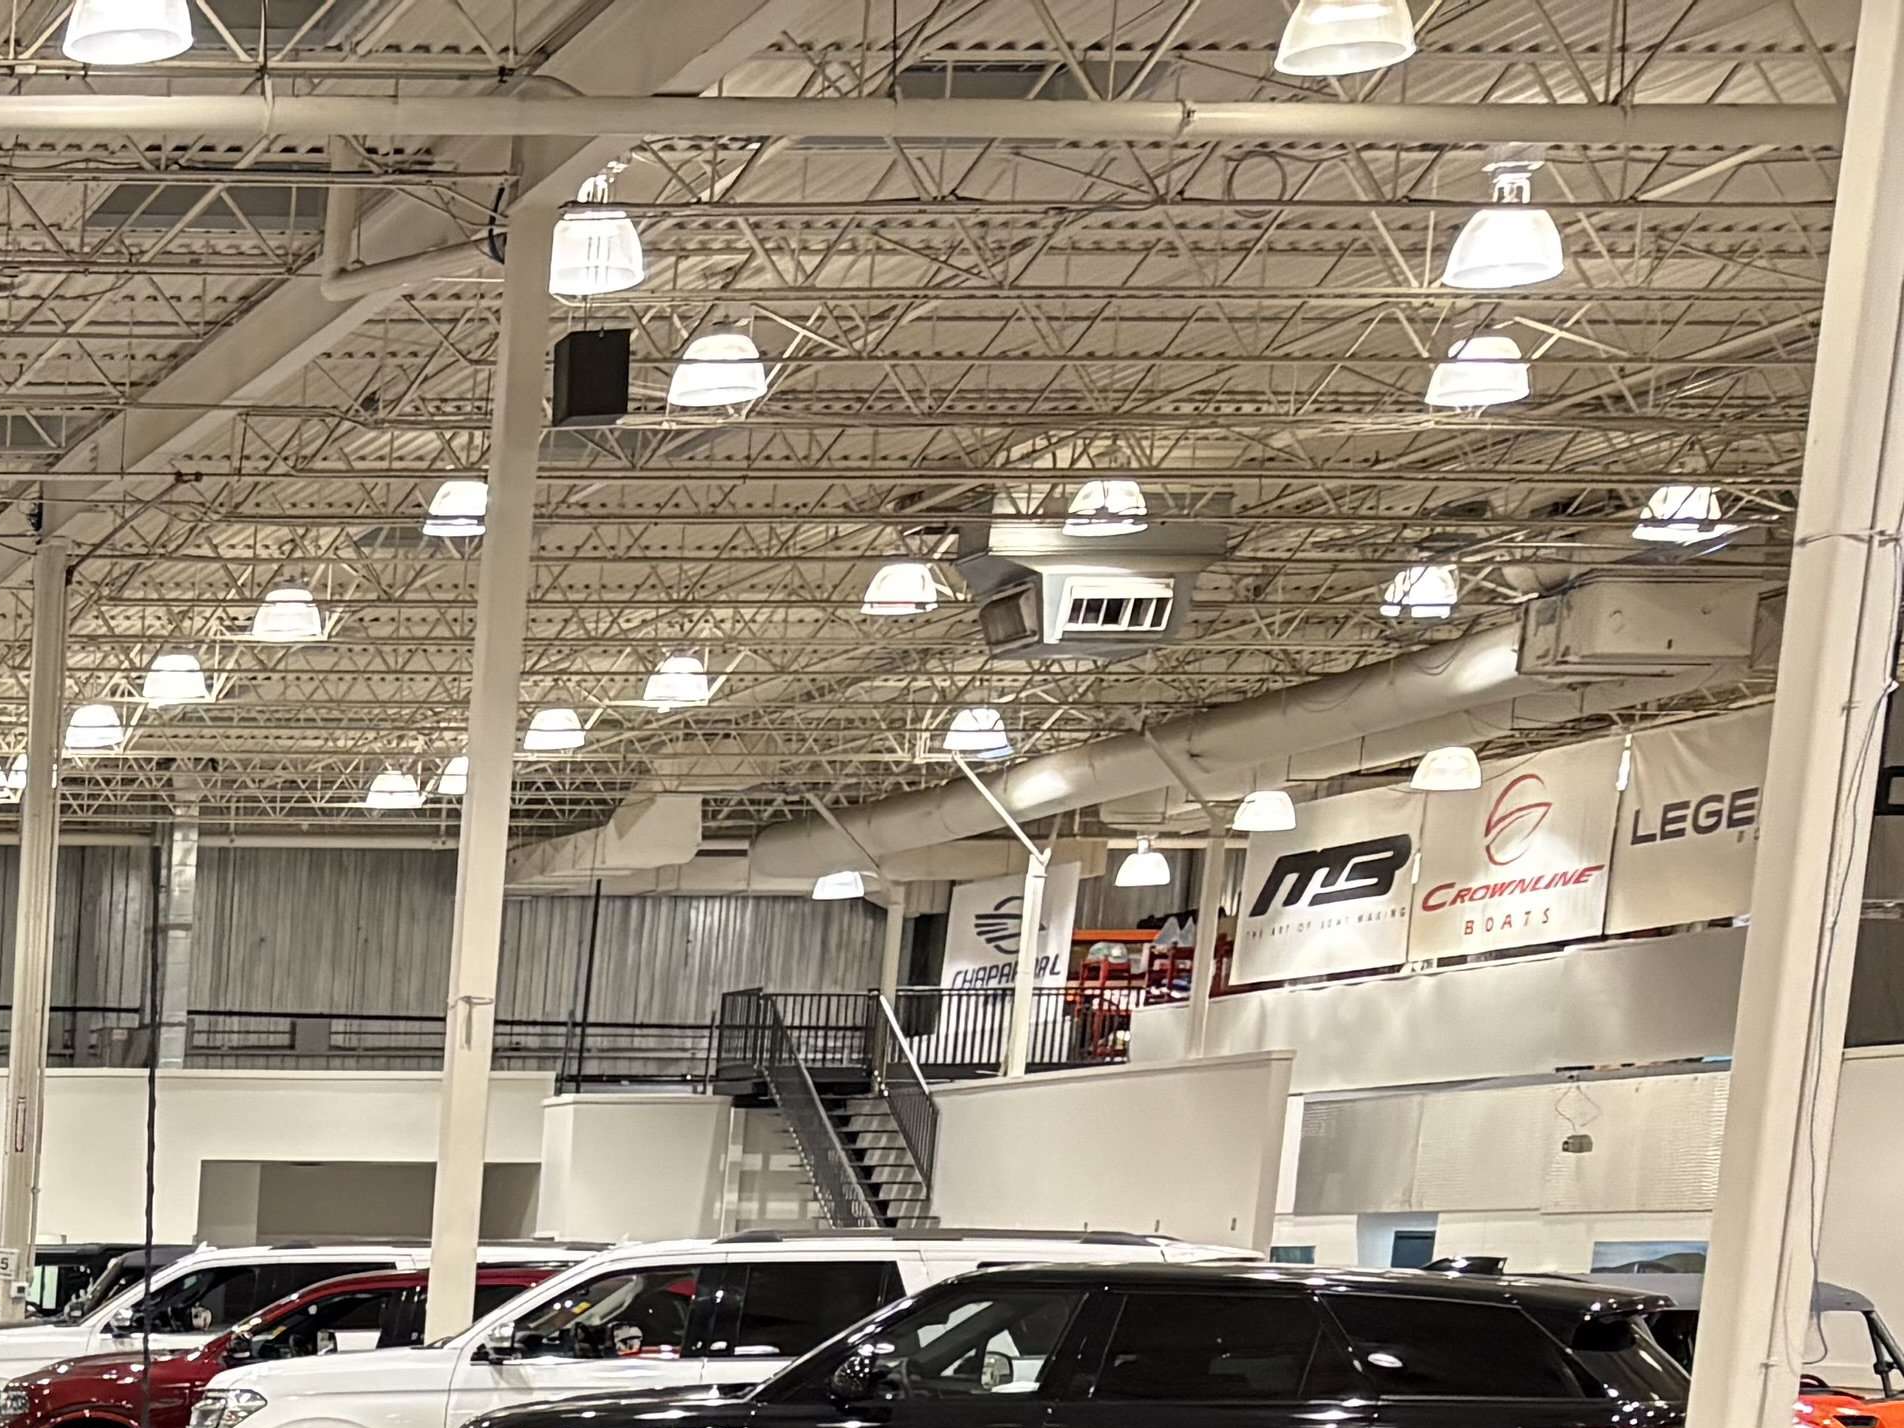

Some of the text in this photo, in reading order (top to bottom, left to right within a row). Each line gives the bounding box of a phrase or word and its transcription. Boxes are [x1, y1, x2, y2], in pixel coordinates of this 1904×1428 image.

[1630, 787, 1759, 845] LEGE
[1248, 834, 1412, 918] MB
[1422, 864, 1606, 912] CROWNLINE
[1464, 908, 1550, 935] BOATS
[953, 954, 1061, 990] CHAPAAL
[0, 1257, 9, 1270] 5
